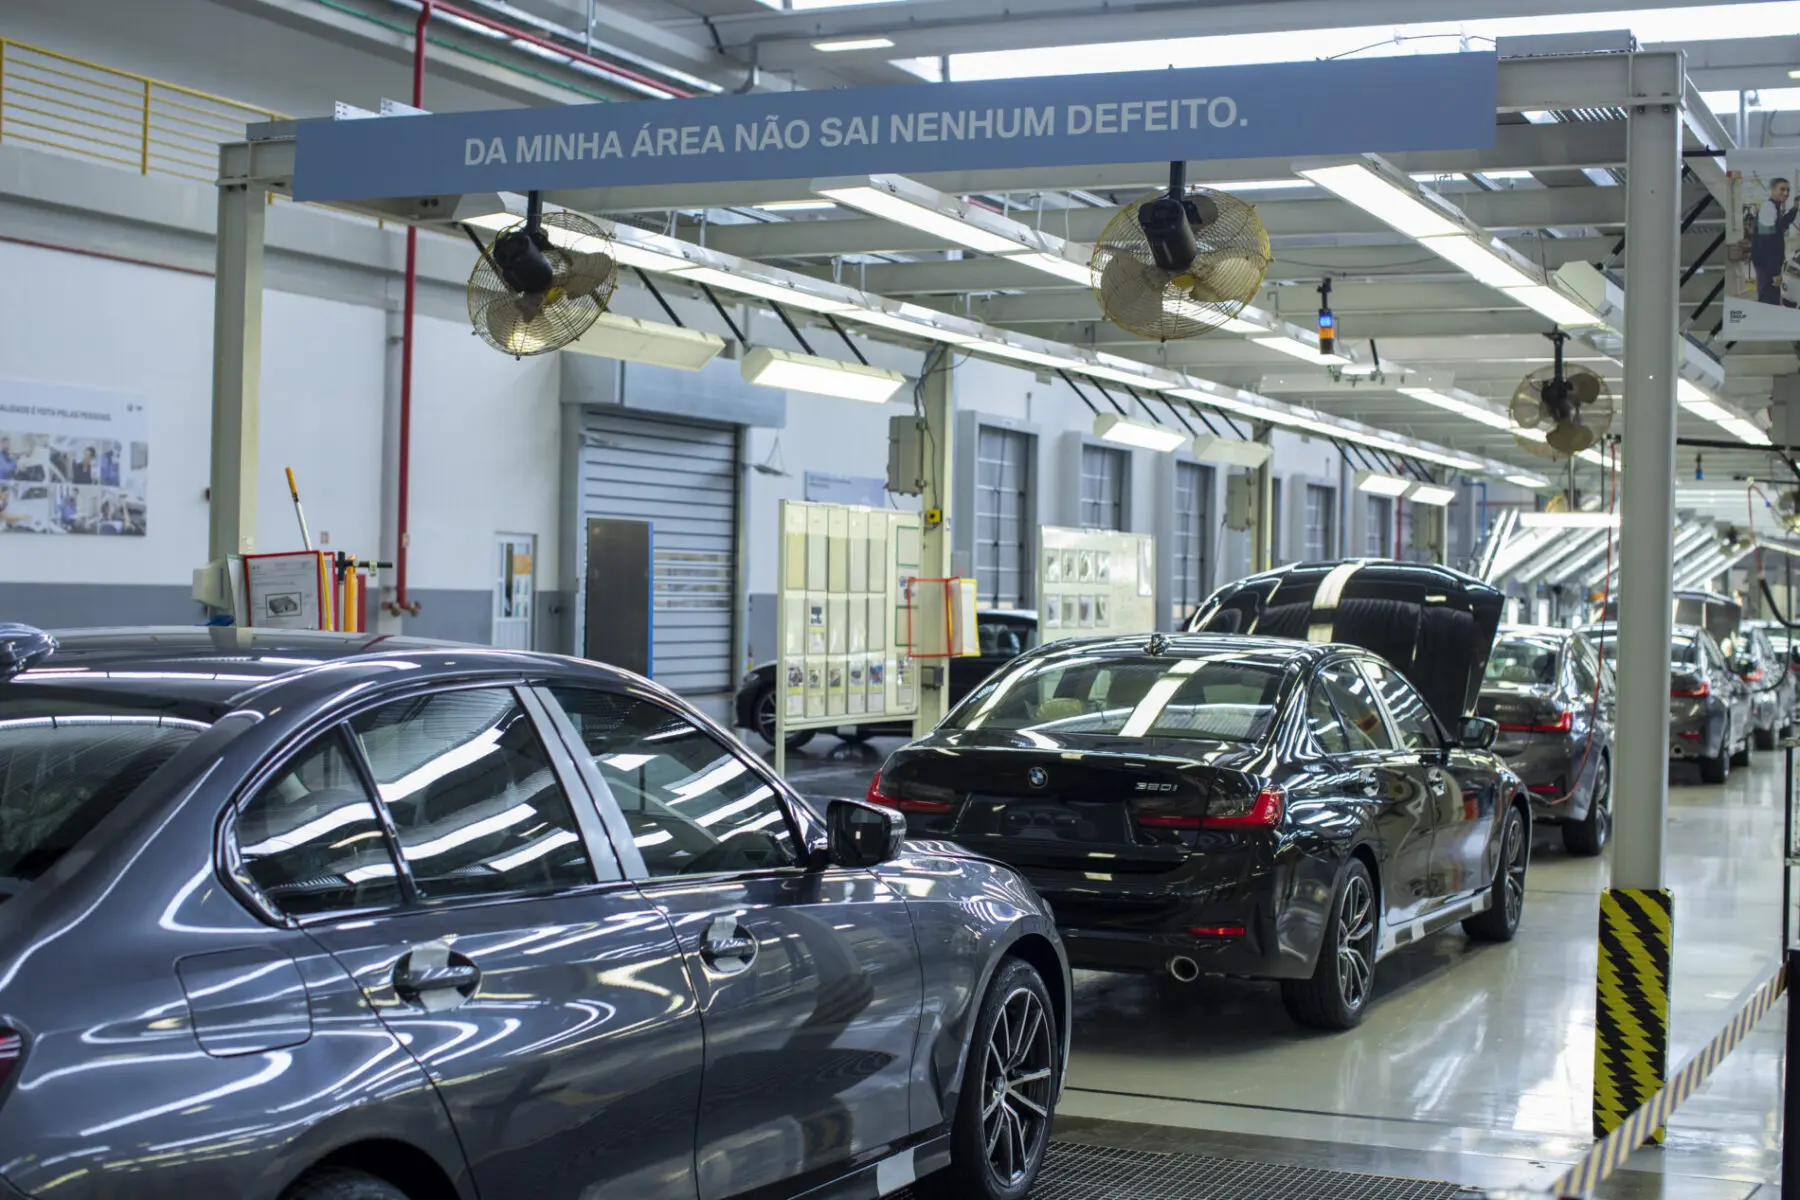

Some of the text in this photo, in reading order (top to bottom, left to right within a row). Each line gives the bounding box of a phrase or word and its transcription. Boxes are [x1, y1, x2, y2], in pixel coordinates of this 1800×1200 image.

[464, 96, 1248, 166] DA MINHA ÁREA NÃO SAI NENHUM DEFEITO.
